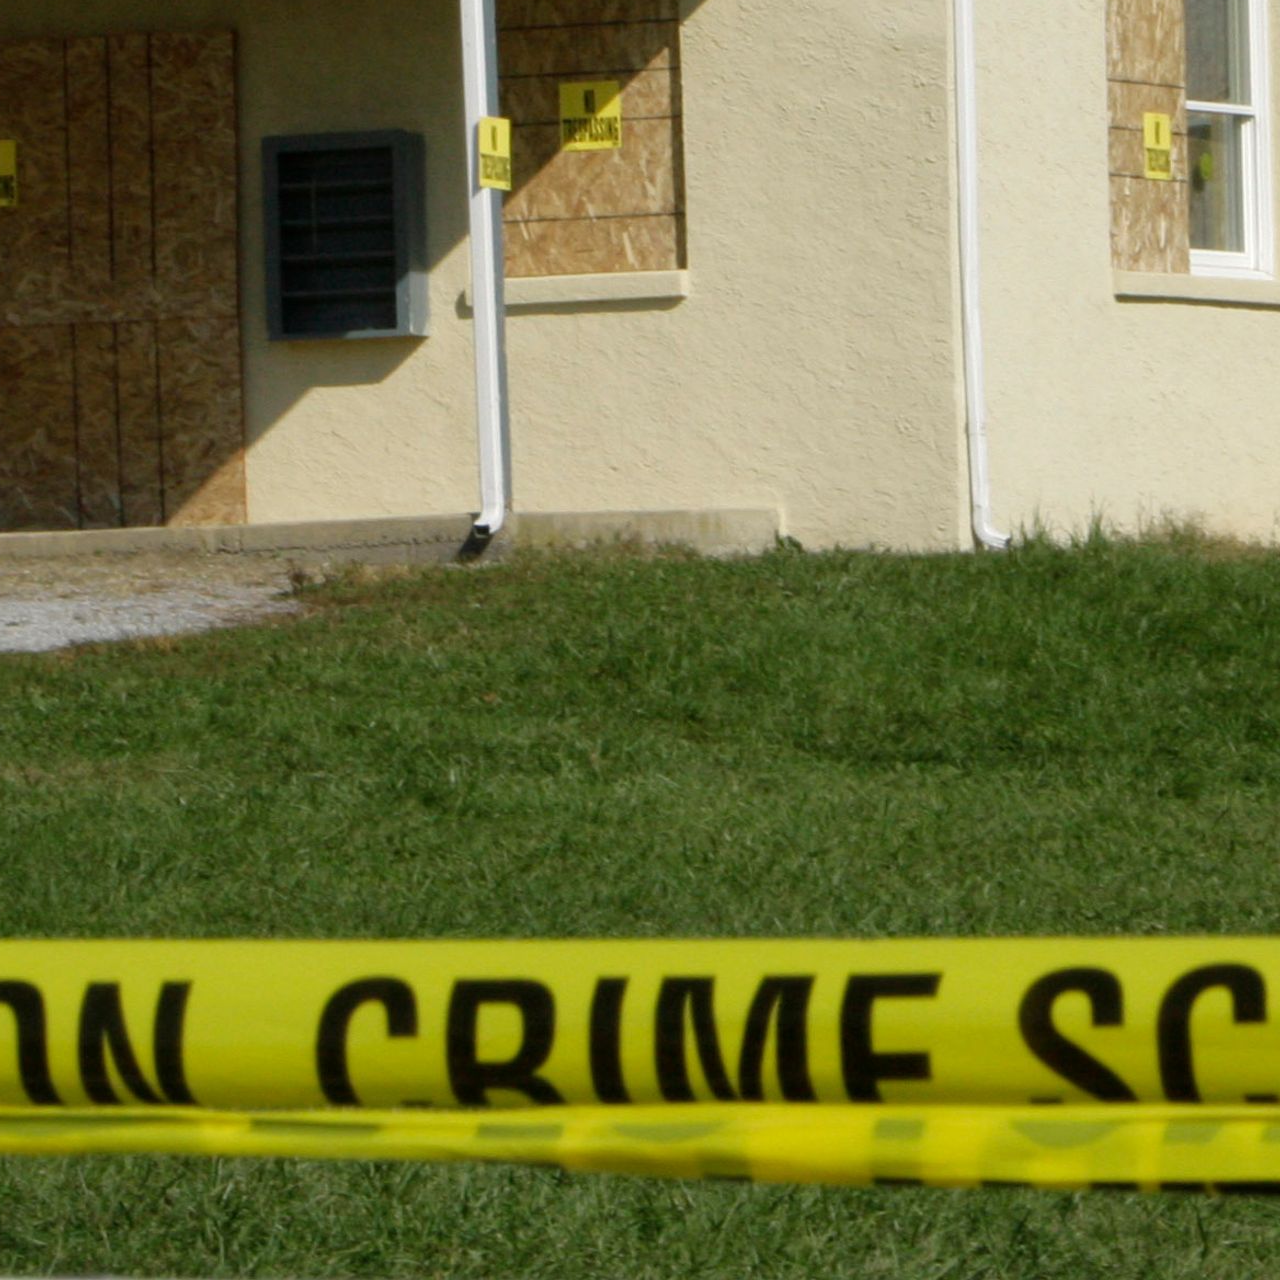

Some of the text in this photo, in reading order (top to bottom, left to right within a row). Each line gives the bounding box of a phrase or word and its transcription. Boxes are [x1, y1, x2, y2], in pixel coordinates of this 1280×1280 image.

[583, 88, 596, 114] NO
[562, 116, 619, 144] TRESPASSING
[314, 974, 943, 1105] CRIME
